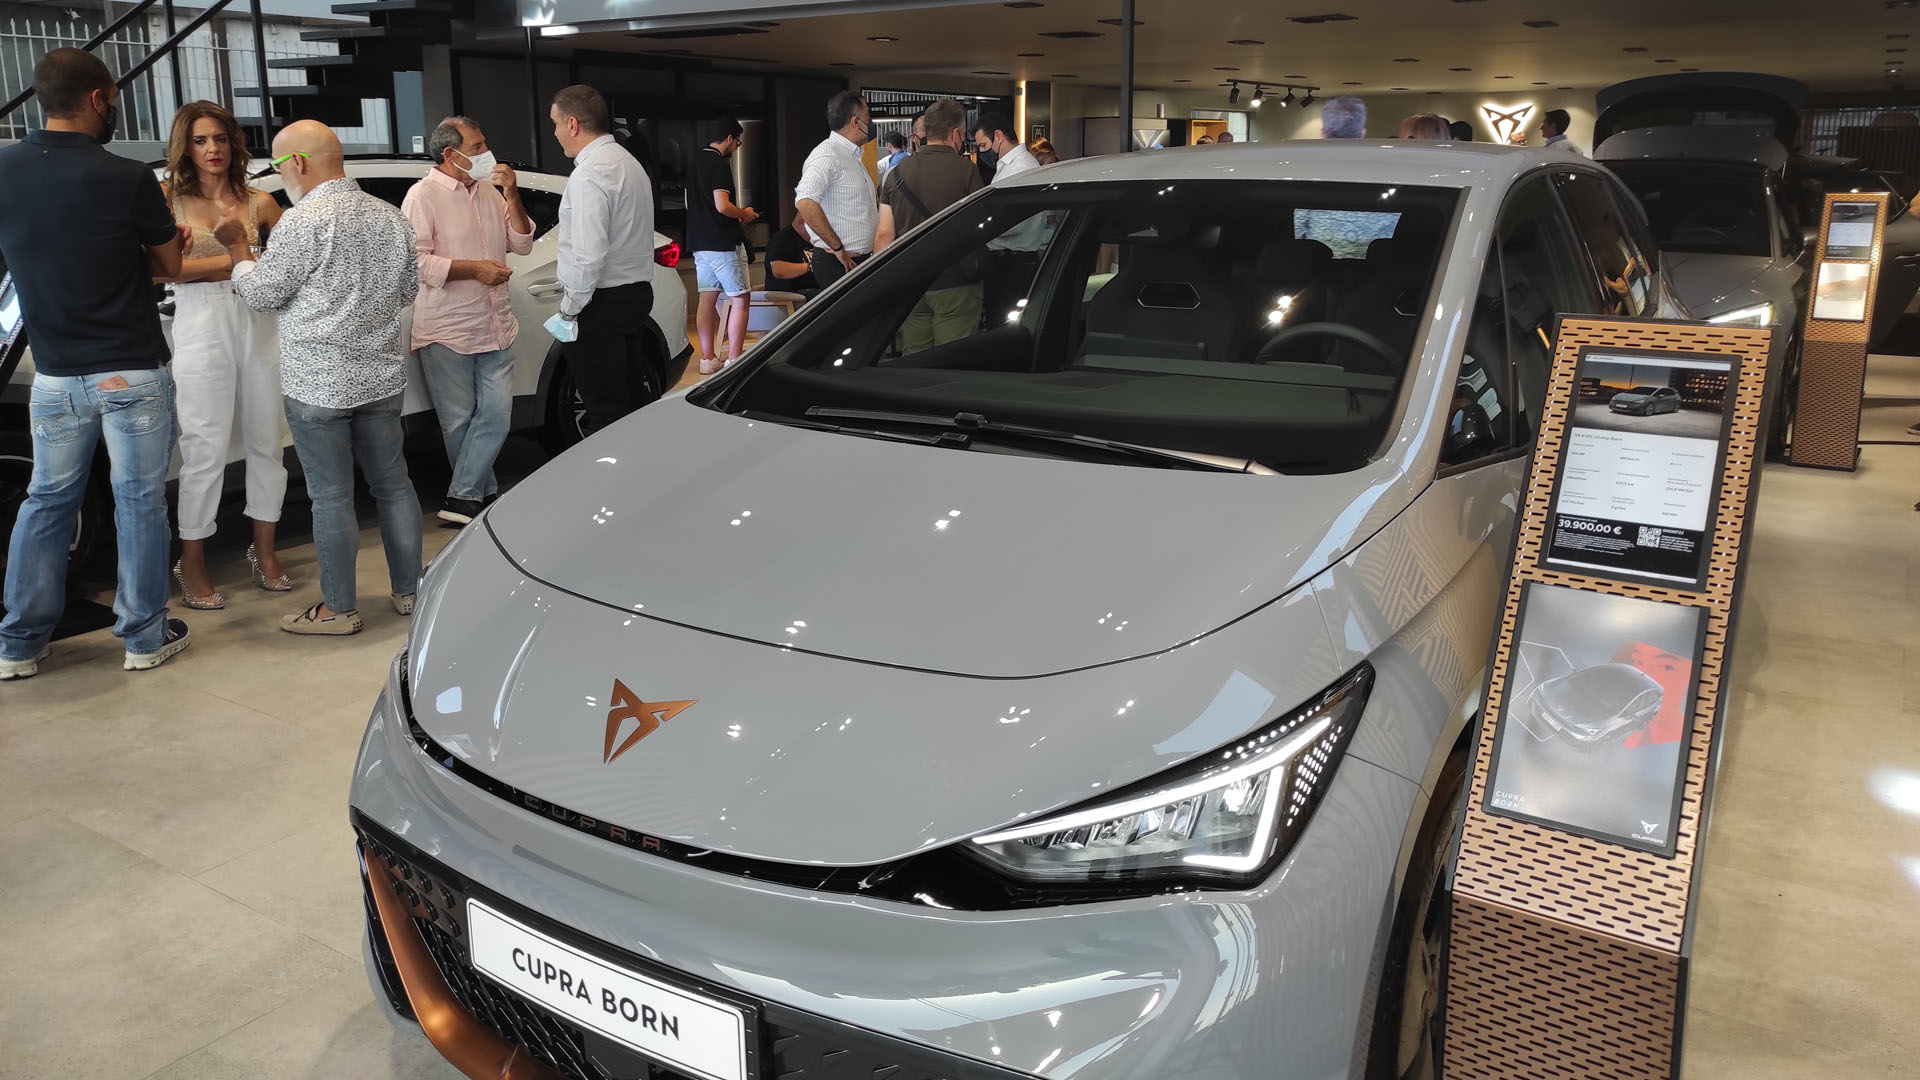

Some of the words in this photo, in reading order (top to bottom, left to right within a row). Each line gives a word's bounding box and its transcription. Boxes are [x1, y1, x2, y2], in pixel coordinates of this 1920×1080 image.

[1558, 519, 1612, 533] 39.900,00
[1613, 526, 1623, 535] €
[1494, 798, 1520, 809] BORN
[1496, 790, 1525, 803] CUPRA
[524, 794, 661, 852] CUPRA
[512, 947, 592, 1005] CUPRA
[601, 986, 680, 1041] BORN
